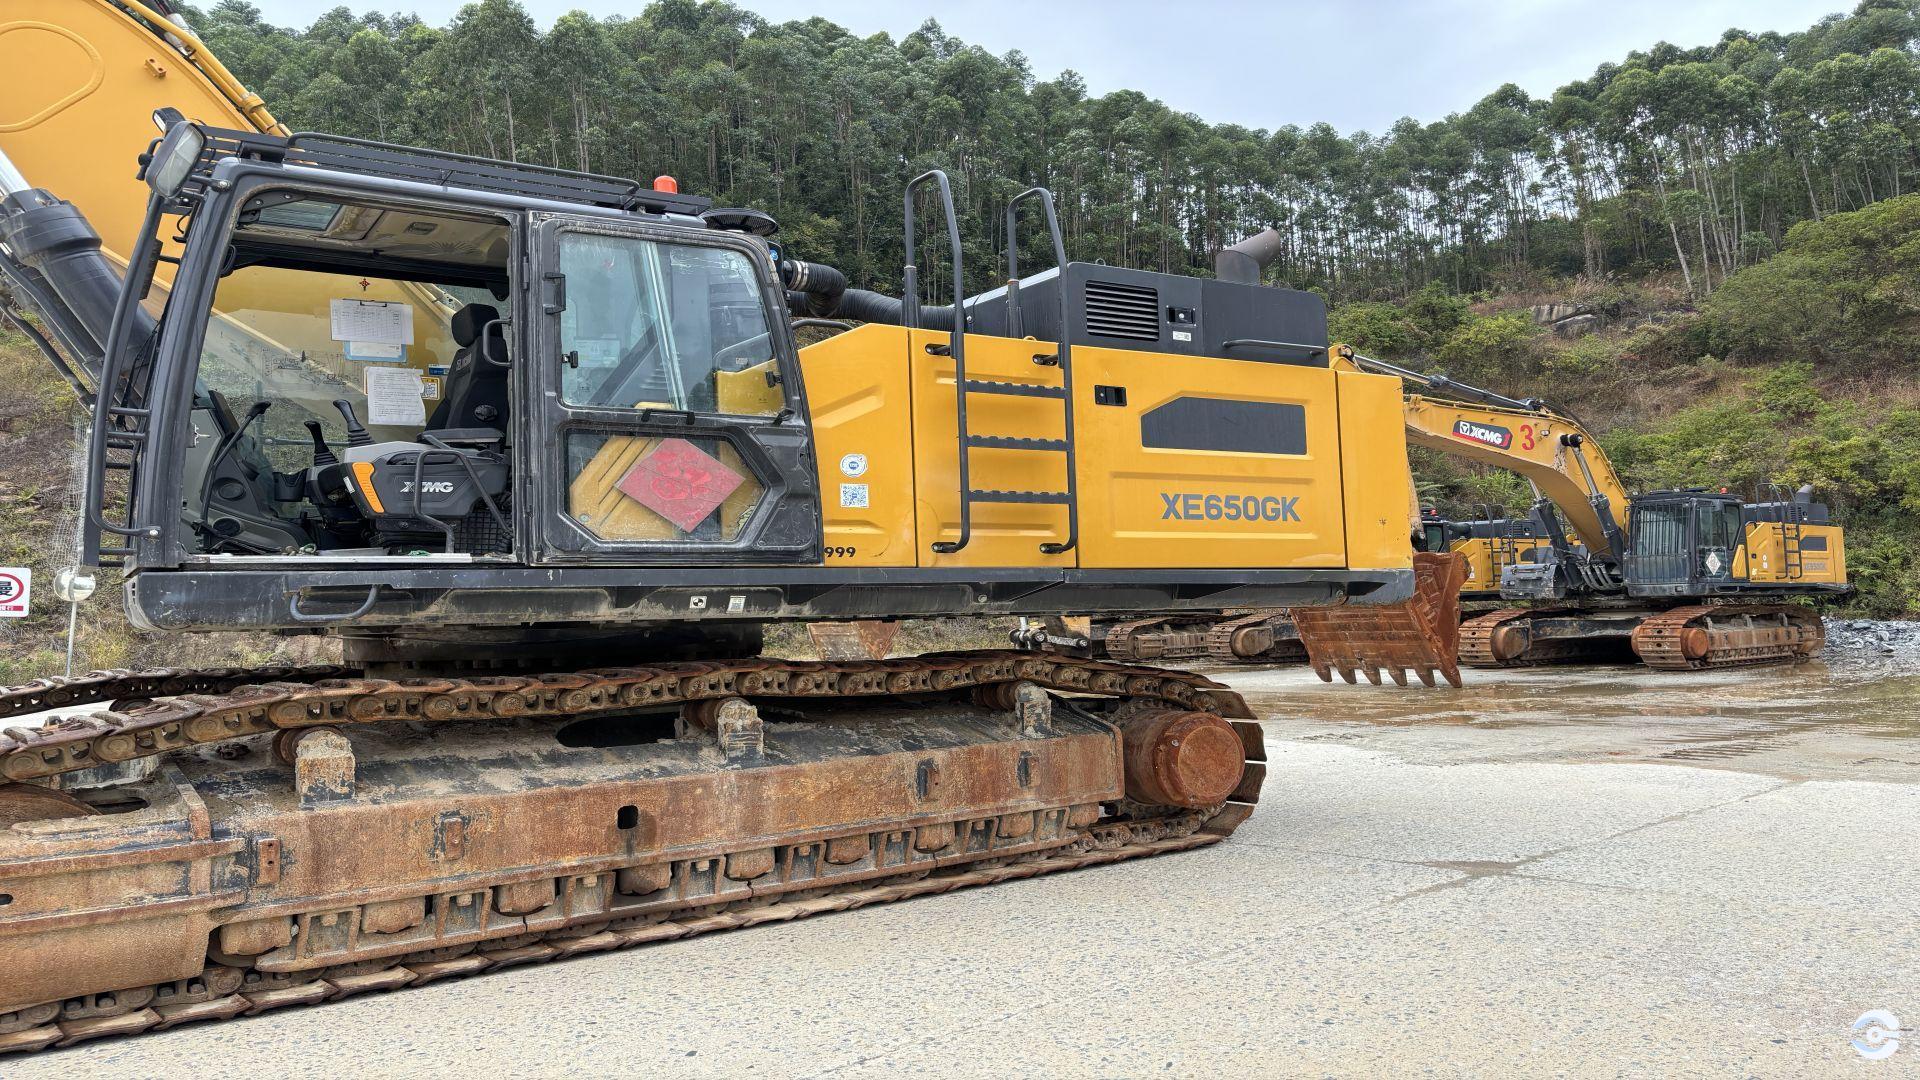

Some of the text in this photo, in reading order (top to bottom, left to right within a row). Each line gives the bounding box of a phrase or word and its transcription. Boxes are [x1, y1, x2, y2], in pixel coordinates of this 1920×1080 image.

[1469, 425, 1503, 444] XCMG
[1519, 424, 1535, 451] 3
[400, 481, 454, 493] XMG
[1160, 492, 1302, 522] XE650GK
[823, 546, 857, 558] 999
